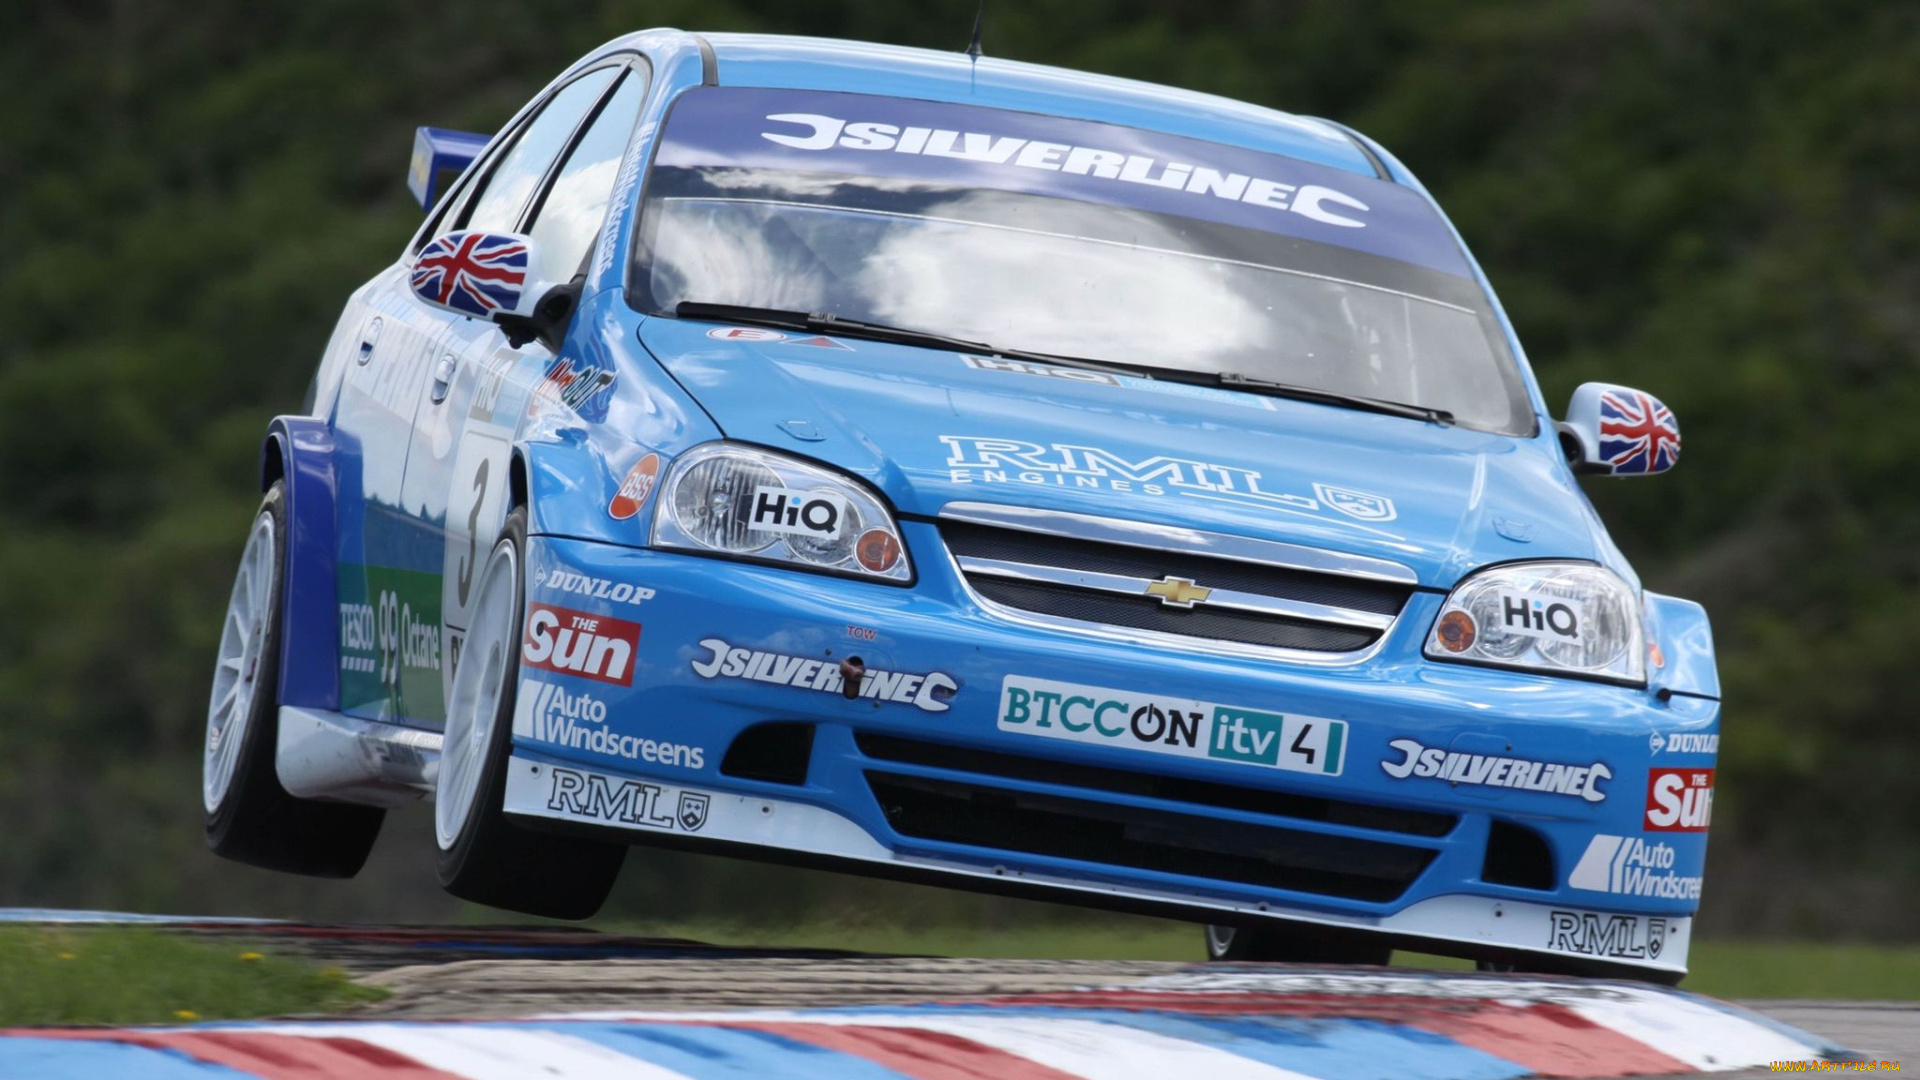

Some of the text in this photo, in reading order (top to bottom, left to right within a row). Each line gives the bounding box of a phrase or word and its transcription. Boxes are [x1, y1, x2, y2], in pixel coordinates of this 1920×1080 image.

[619, 472, 655, 501] BSS
[939, 434, 1319, 511] RML
[950, 468, 1165, 496] ENGINES
[457, 457, 490, 609] 3
[754, 492, 838, 534] HiQ
[546, 570, 656, 605] DUNLOP
[340, 602, 375, 652] TESCO
[379, 589, 399, 685] 99
[402, 602, 440, 671] Octane
[572, 616, 599, 632] THE
[847, 625, 877, 641] TOW
[1503, 595, 1579, 640] HiQ
[524, 609, 632, 680] Sun
[549, 686, 607, 723] Auto
[547, 713, 705, 769] Windscreens
[1215, 714, 1276, 756] itv
[1290, 723, 1316, 764] 4
[548, 768, 675, 829] RML
[1692, 773, 1708, 787] THE
[1626, 838, 1676, 870] Auto
[1548, 910, 1646, 959] RML
